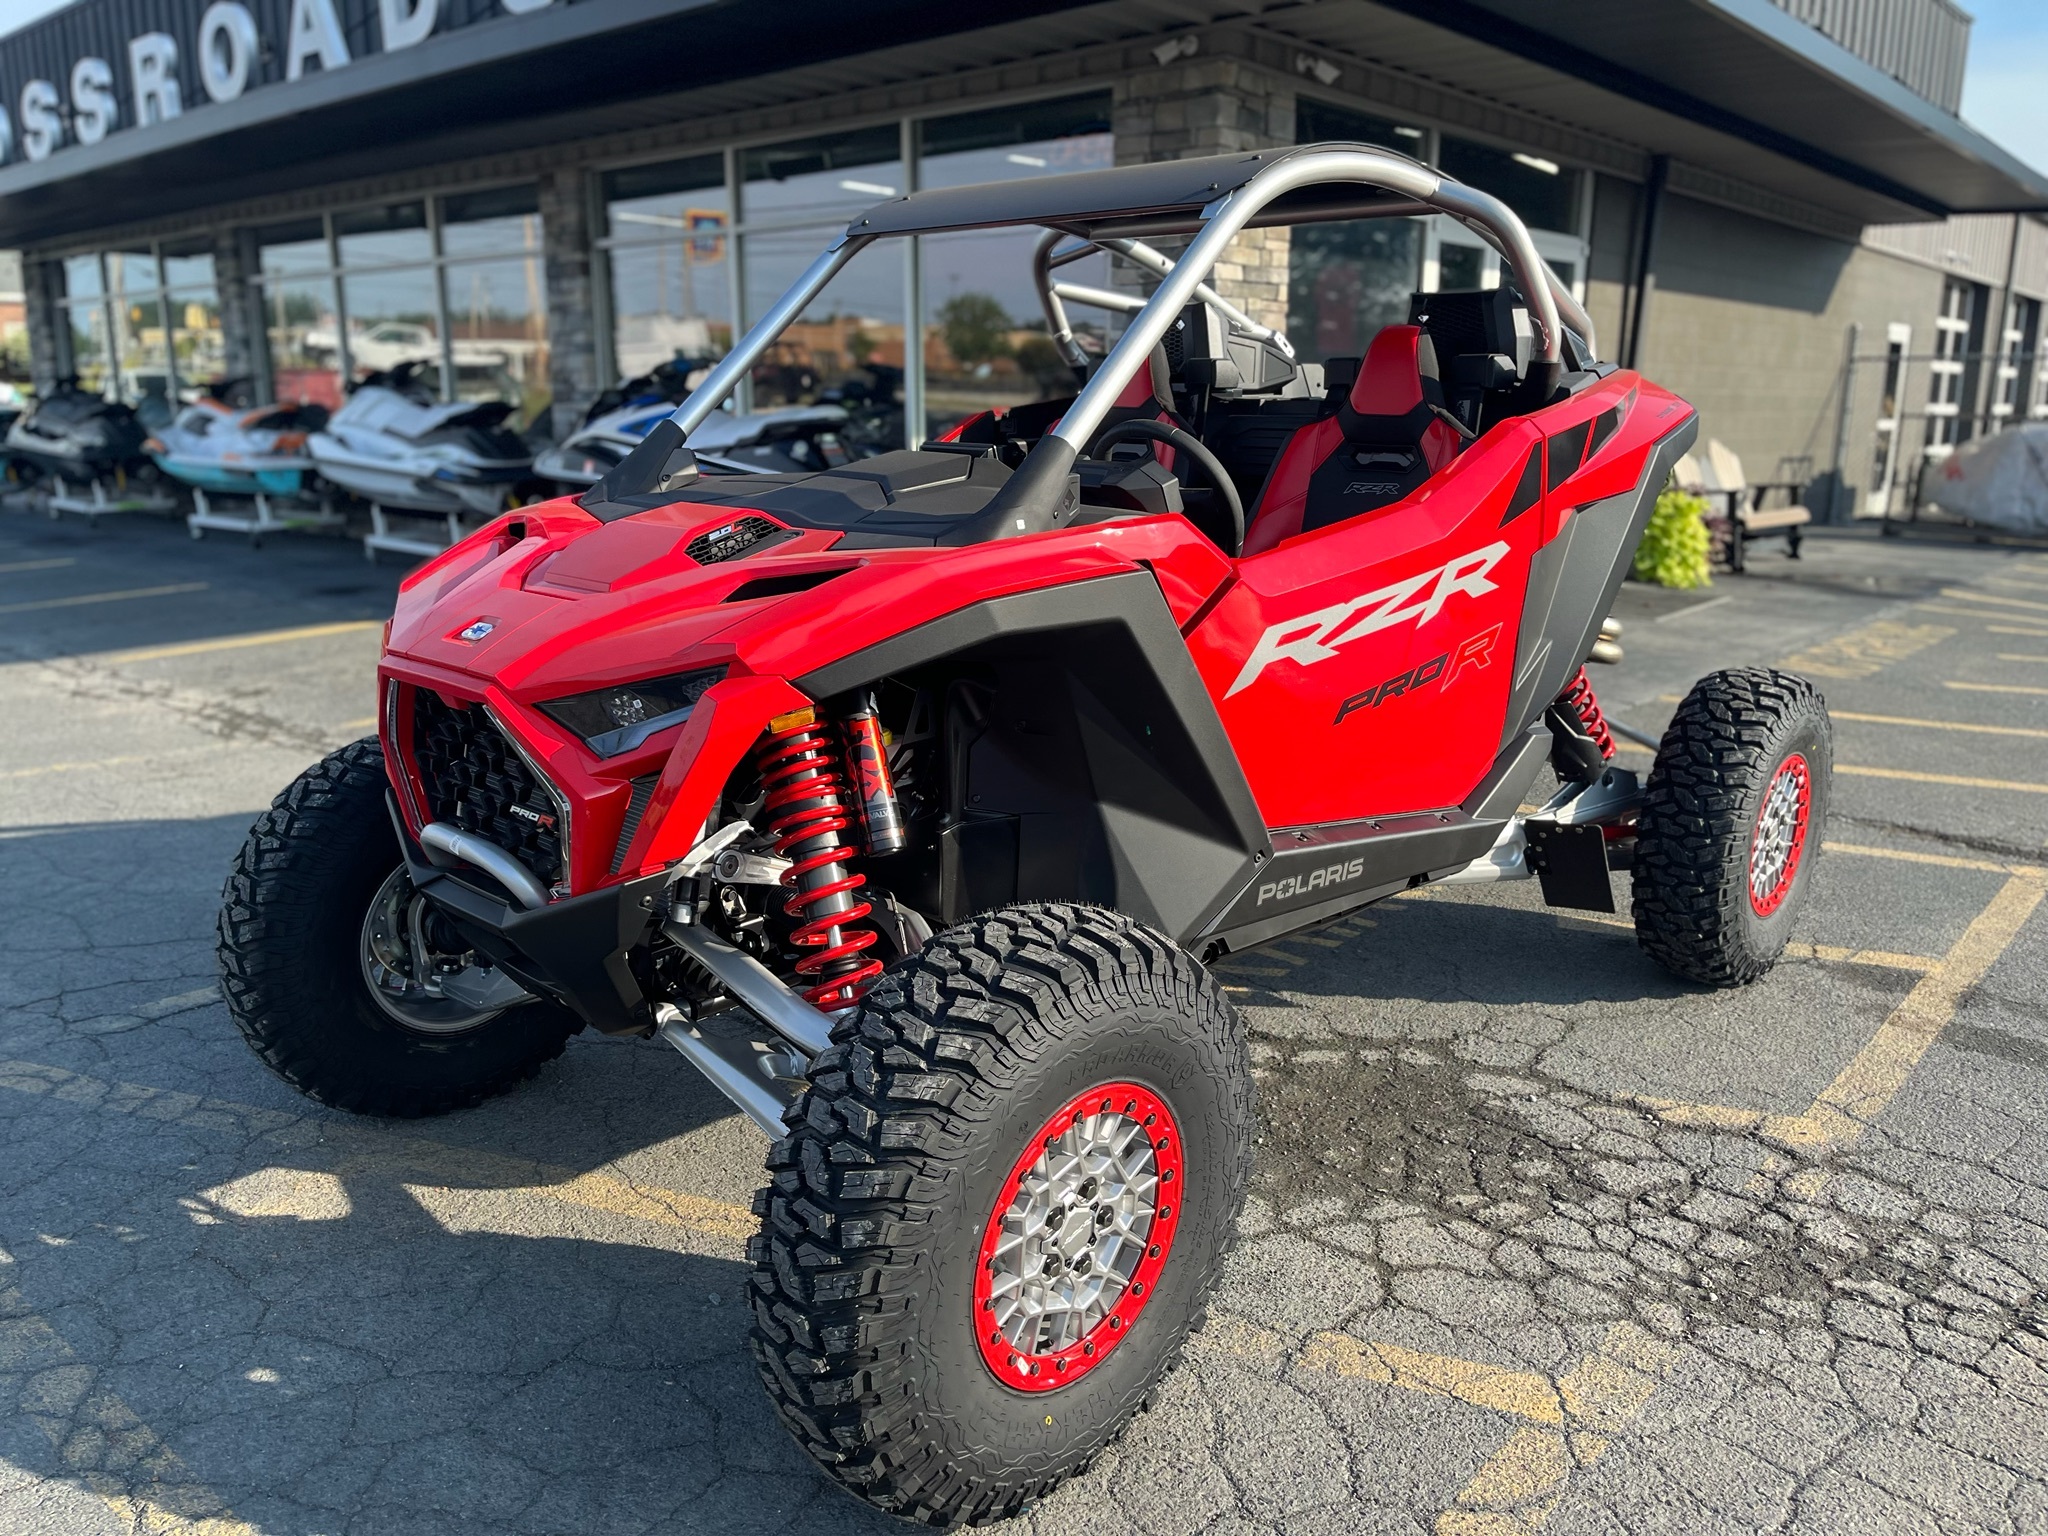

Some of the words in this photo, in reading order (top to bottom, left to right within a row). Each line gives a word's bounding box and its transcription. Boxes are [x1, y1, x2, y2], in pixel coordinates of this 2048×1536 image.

[0, 0, 553, 166] SSROAD
[1343, 481, 1400, 495] RZR
[1222, 540, 1511, 701] RZR
[510, 805, 539, 821] PRO
[1256, 857, 1365, 906] POLARIS
